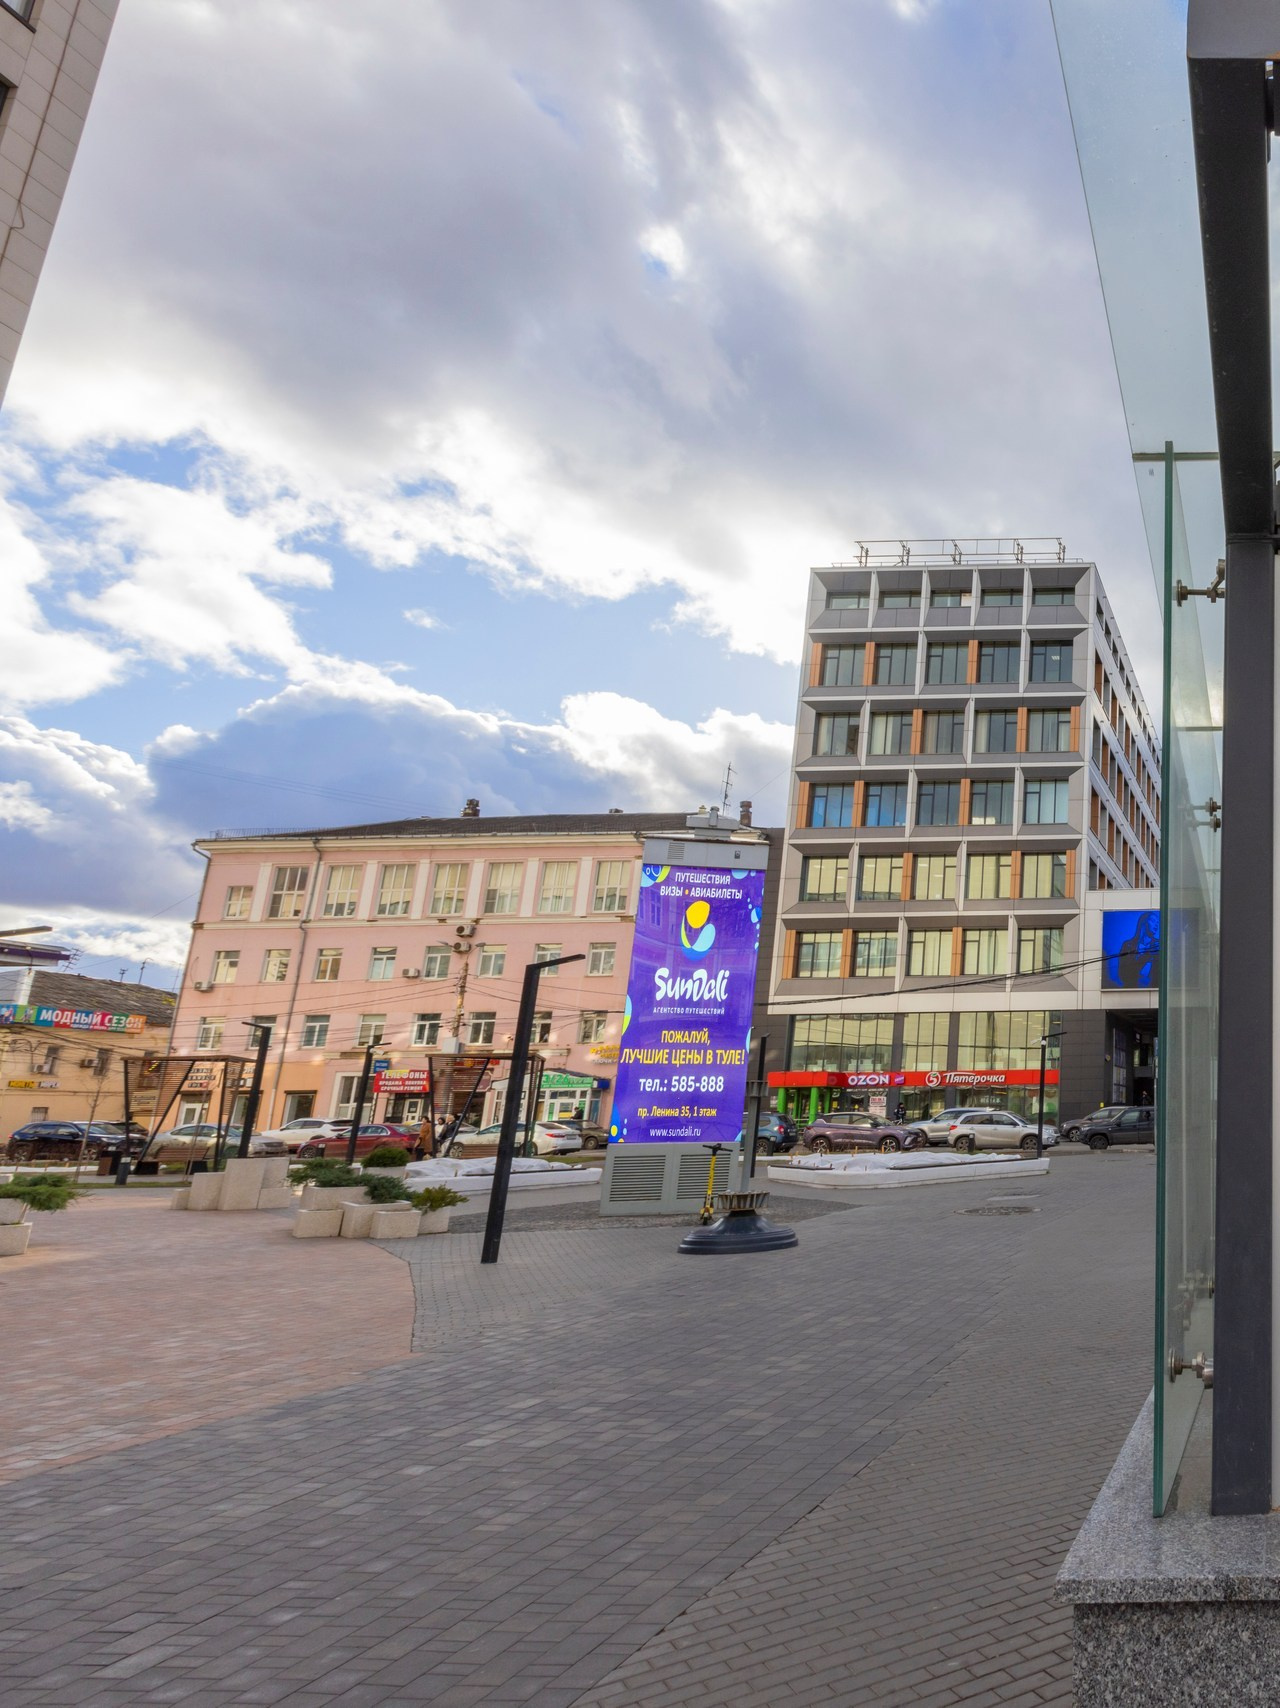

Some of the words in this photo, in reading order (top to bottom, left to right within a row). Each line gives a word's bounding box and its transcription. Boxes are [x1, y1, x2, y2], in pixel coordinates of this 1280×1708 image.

[675, 872, 731, 885] ПУТЕШЕСТВИЯ
[660, 886, 683, 897] ВИЗЫ
[690, 887, 742, 899] АВИАБИЛЕТЫ
[685, 1007, 725, 1015] ПУТЕШЕСТВИЙ
[40, 1009, 102, 1026] МОДНЫЙ
[104, 1015, 144, 1029] СЕЗОН
[661, 1028, 710, 1046] ПОЖАЛУЙ,
[620, 1048, 669, 1064] ЛУЧШИЕ
[671, 1049, 704, 1068] ЦЕНЫ
[706, 1049, 714, 1065] В
[716, 1049, 745, 1065] ТУЛЕ!
[381, 1071, 427, 1079] ТЕЛЕФОНЫ
[848, 1073, 890, 1086] OZON
[943, 1072, 1005, 1085] Пятерочка
[639, 1077, 668, 1092] тел.:
[671, 1076, 724, 1092] 585-888
[637, 1107, 649, 1119] пр.
[650, 1105, 679, 1117] Ленина
[681, 1106, 692, 1119] 35,
[693, 1106, 698, 1117] 1
[699, 1108, 717, 1117] этаж
[649, 1126, 701, 1137] www.sundali.ru
